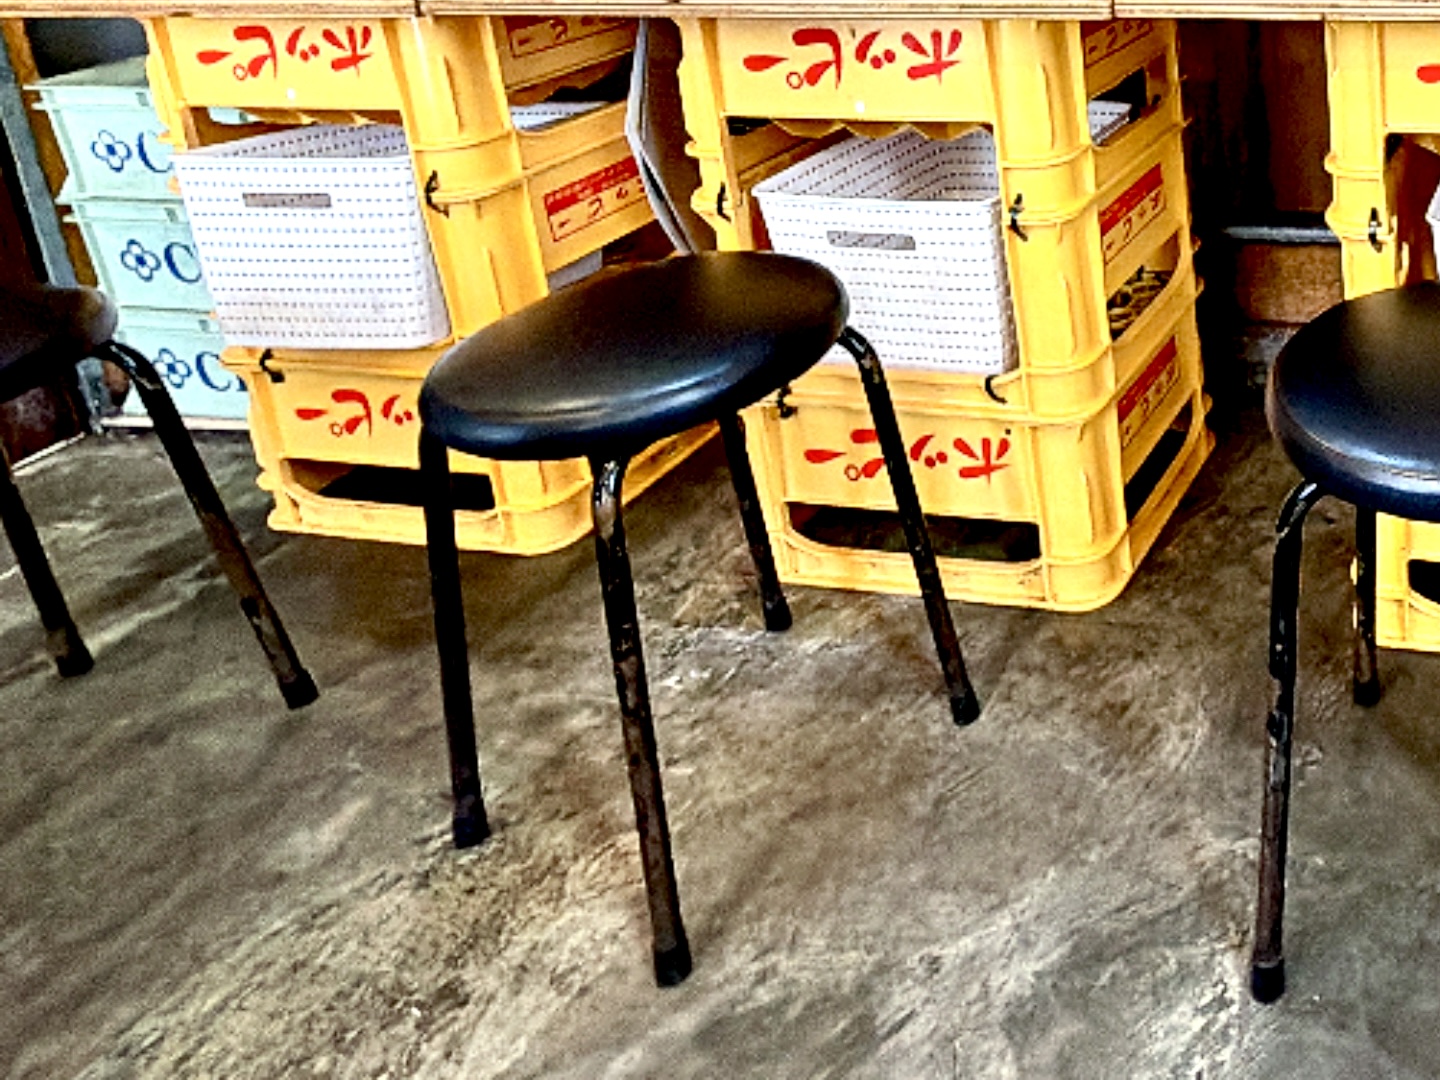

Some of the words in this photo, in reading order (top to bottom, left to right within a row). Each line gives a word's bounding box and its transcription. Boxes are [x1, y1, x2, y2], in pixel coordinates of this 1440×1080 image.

[197, 25, 373, 81] ホッピー
[743, 27, 963, 91] ホッピー
[295, 389, 413, 438] ッピー
